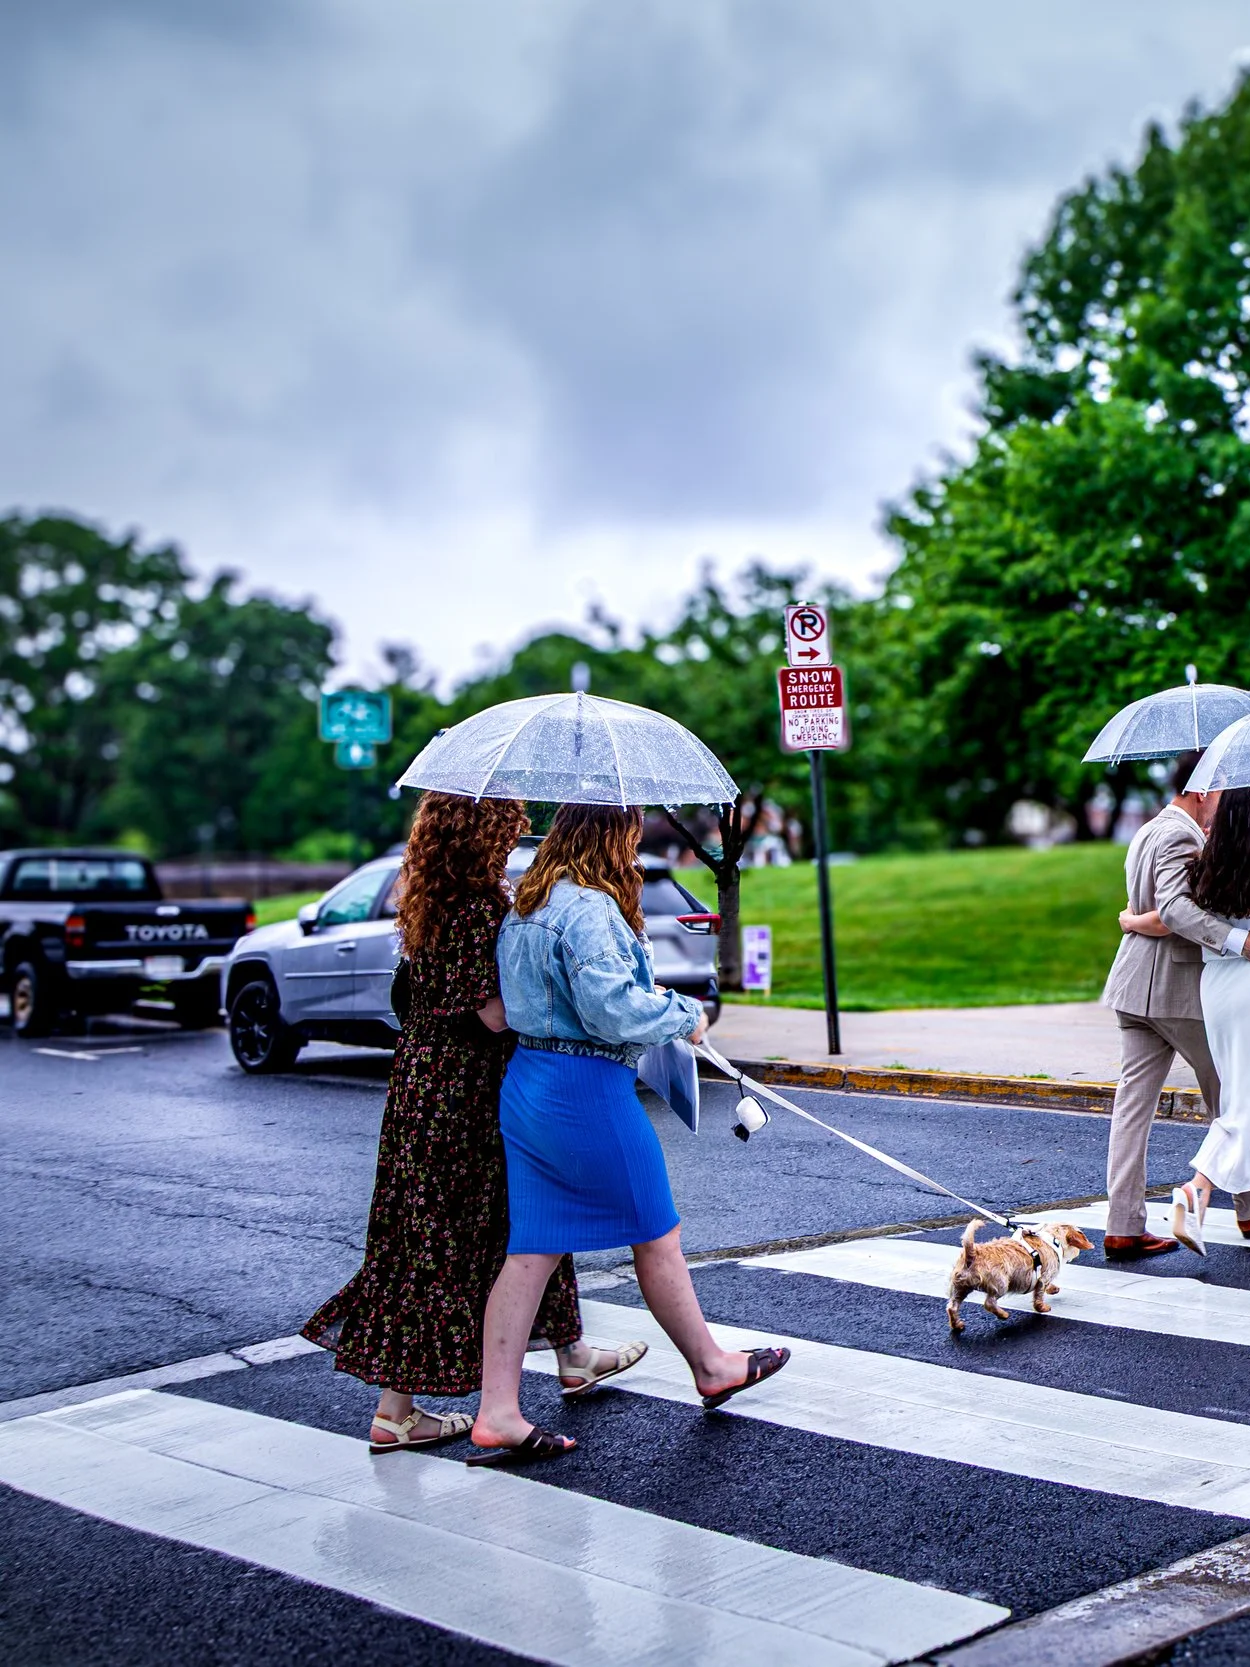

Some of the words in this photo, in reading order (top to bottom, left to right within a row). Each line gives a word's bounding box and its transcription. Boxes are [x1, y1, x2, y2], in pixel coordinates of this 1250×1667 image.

[788, 671, 833, 684] SNOW
[787, 683, 836, 694] EMERGENCY
[790, 694, 835, 707] ROUTE
[788, 718, 800, 727] NO
[804, 716, 839, 725] PARKING
[800, 725, 829, 734] DURING
[791, 732, 838, 742] EMERGENCY
[125, 924, 208, 941] TOYOTA
